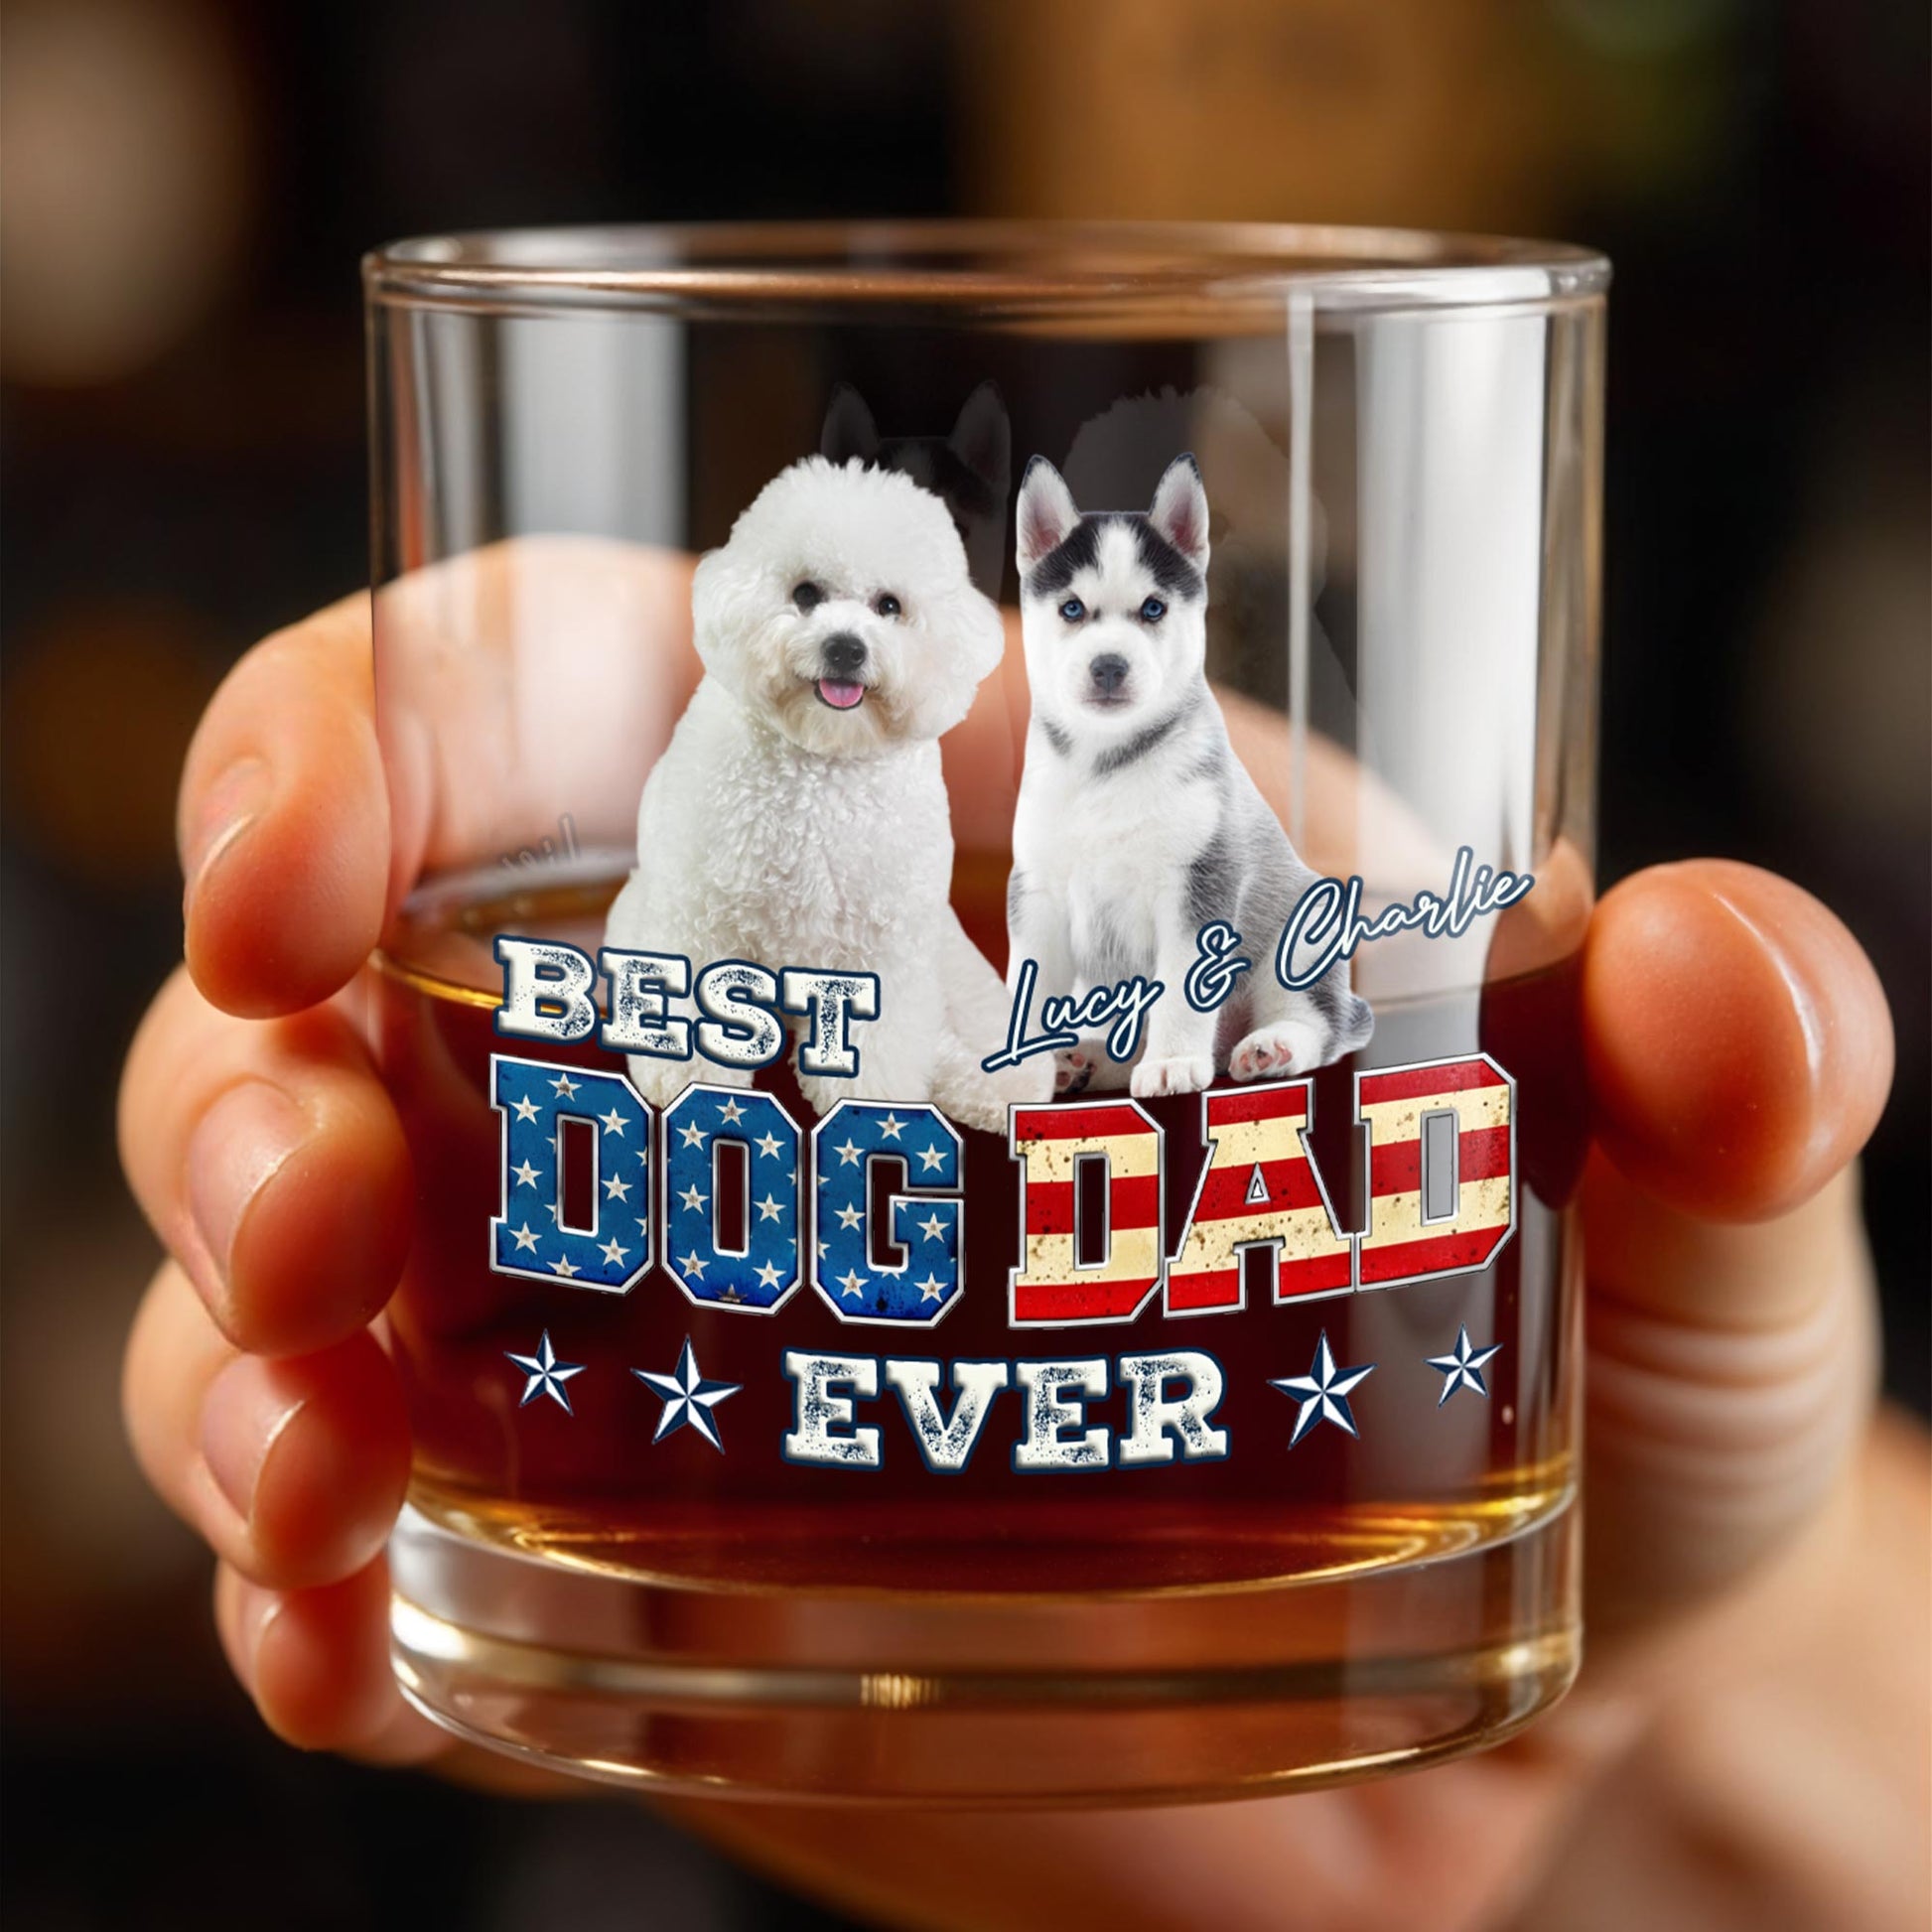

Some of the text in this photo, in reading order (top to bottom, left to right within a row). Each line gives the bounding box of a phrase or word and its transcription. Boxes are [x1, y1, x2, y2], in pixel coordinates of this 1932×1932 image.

[493, 936, 881, 1077] BEST
[981, 845, 1535, 1073] Lucy & Charlie
[488, 1052, 1517, 1329] DOG DAD
[782, 1348, 1230, 1474] EVER
